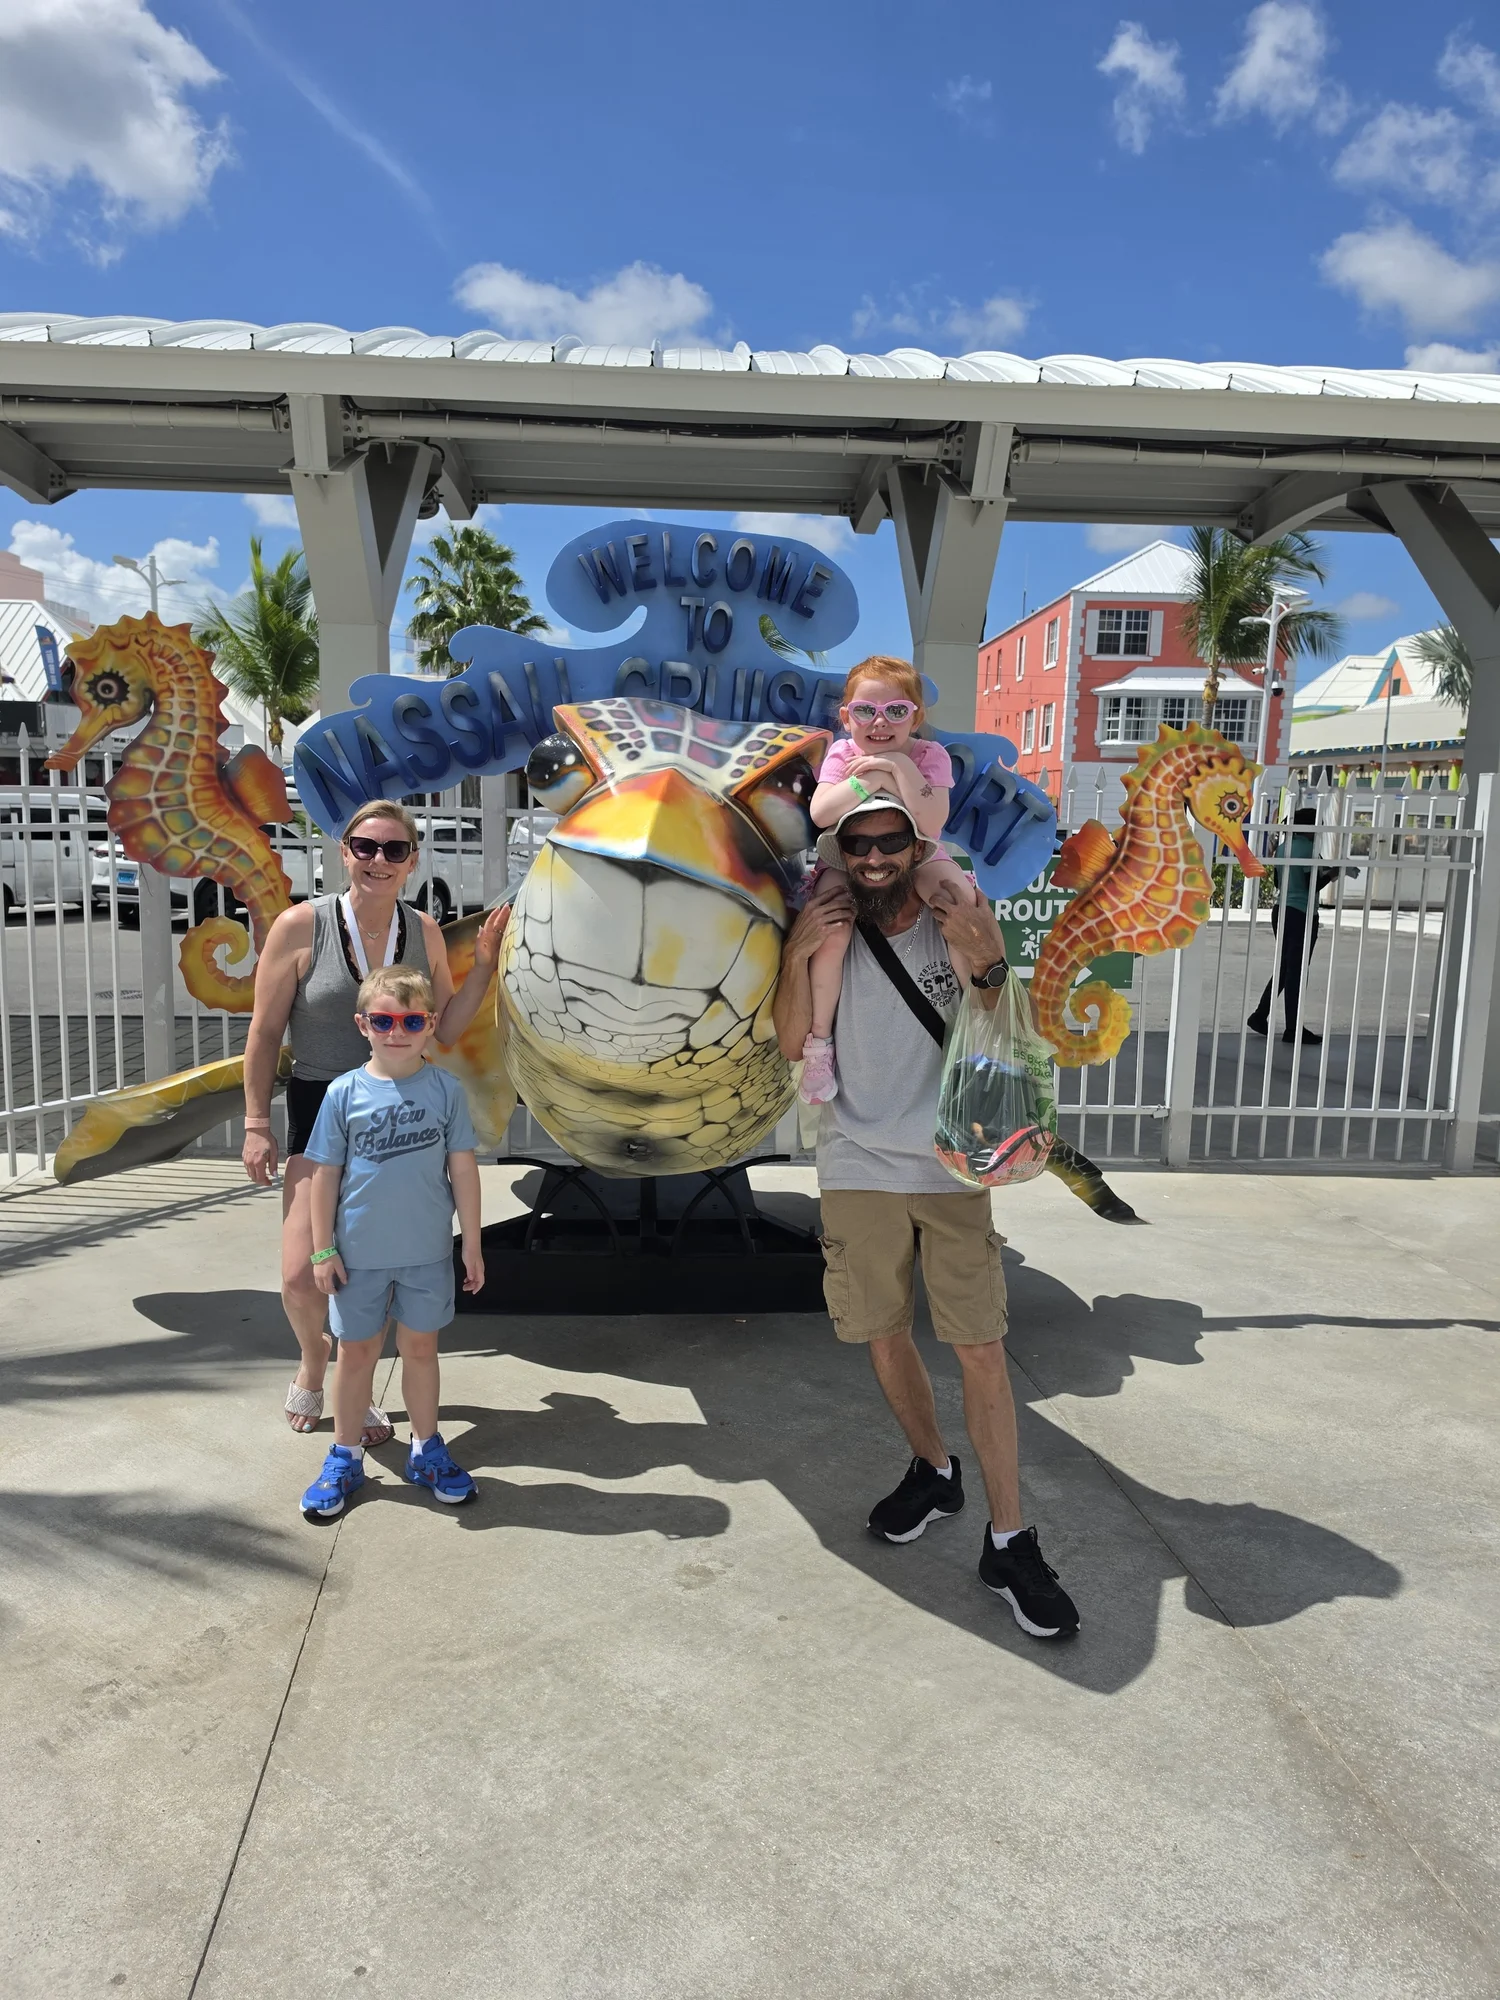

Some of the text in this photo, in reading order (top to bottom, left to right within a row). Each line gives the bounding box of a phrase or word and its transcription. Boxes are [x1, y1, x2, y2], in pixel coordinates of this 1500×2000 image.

[577, 531, 834, 619] WELCOME
[680, 596, 733, 654] TO
[294, 656, 573, 823] NASSAU
[914, 727, 1053, 866] ORT
[994, 899, 1067, 922] ROUT
[917, 961, 938, 983] MYRTLE
[370, 1099, 426, 1134] New
[354, 1127, 440, 1158] Balance
